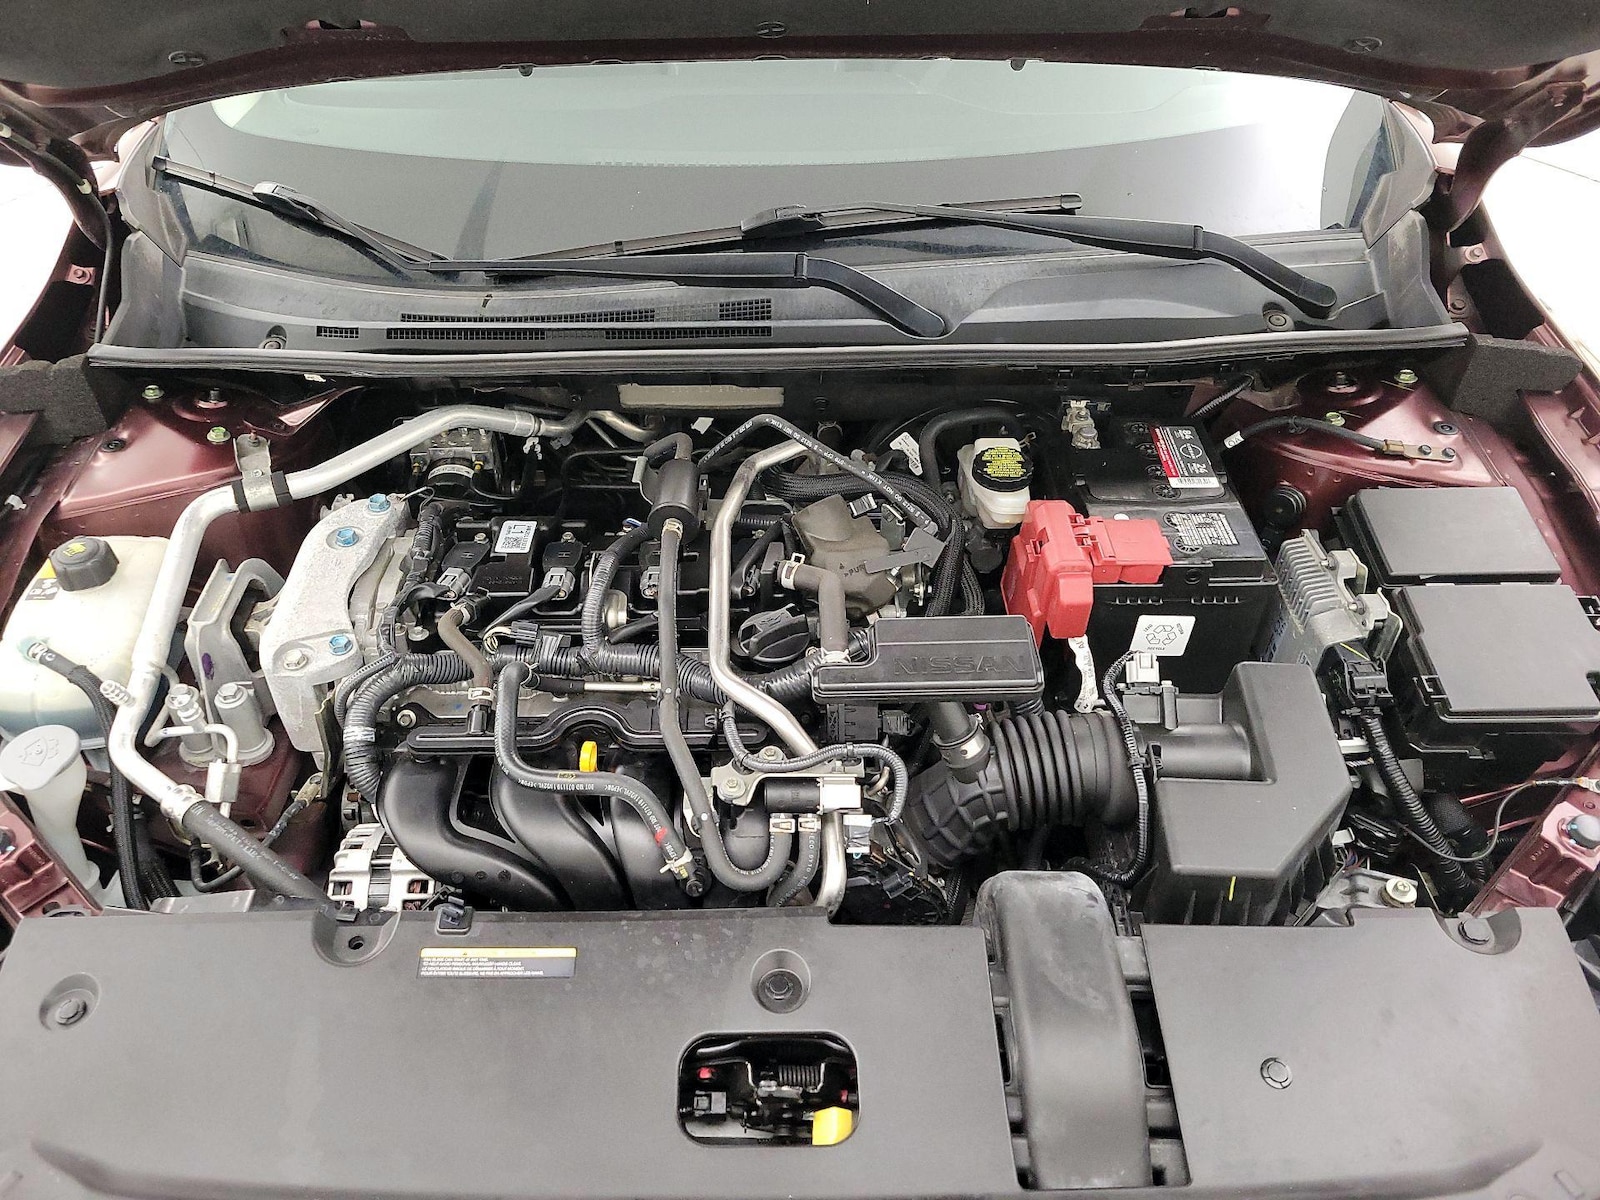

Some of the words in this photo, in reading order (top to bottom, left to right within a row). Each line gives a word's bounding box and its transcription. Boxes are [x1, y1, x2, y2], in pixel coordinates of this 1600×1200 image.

[783, 426, 794, 436] NOT
[867, 473, 883, 486] KINK
[882, 484, 894, 495] NOT
[511, 524, 527, 534] L1
[893, 655, 1026, 676] NISSAN
